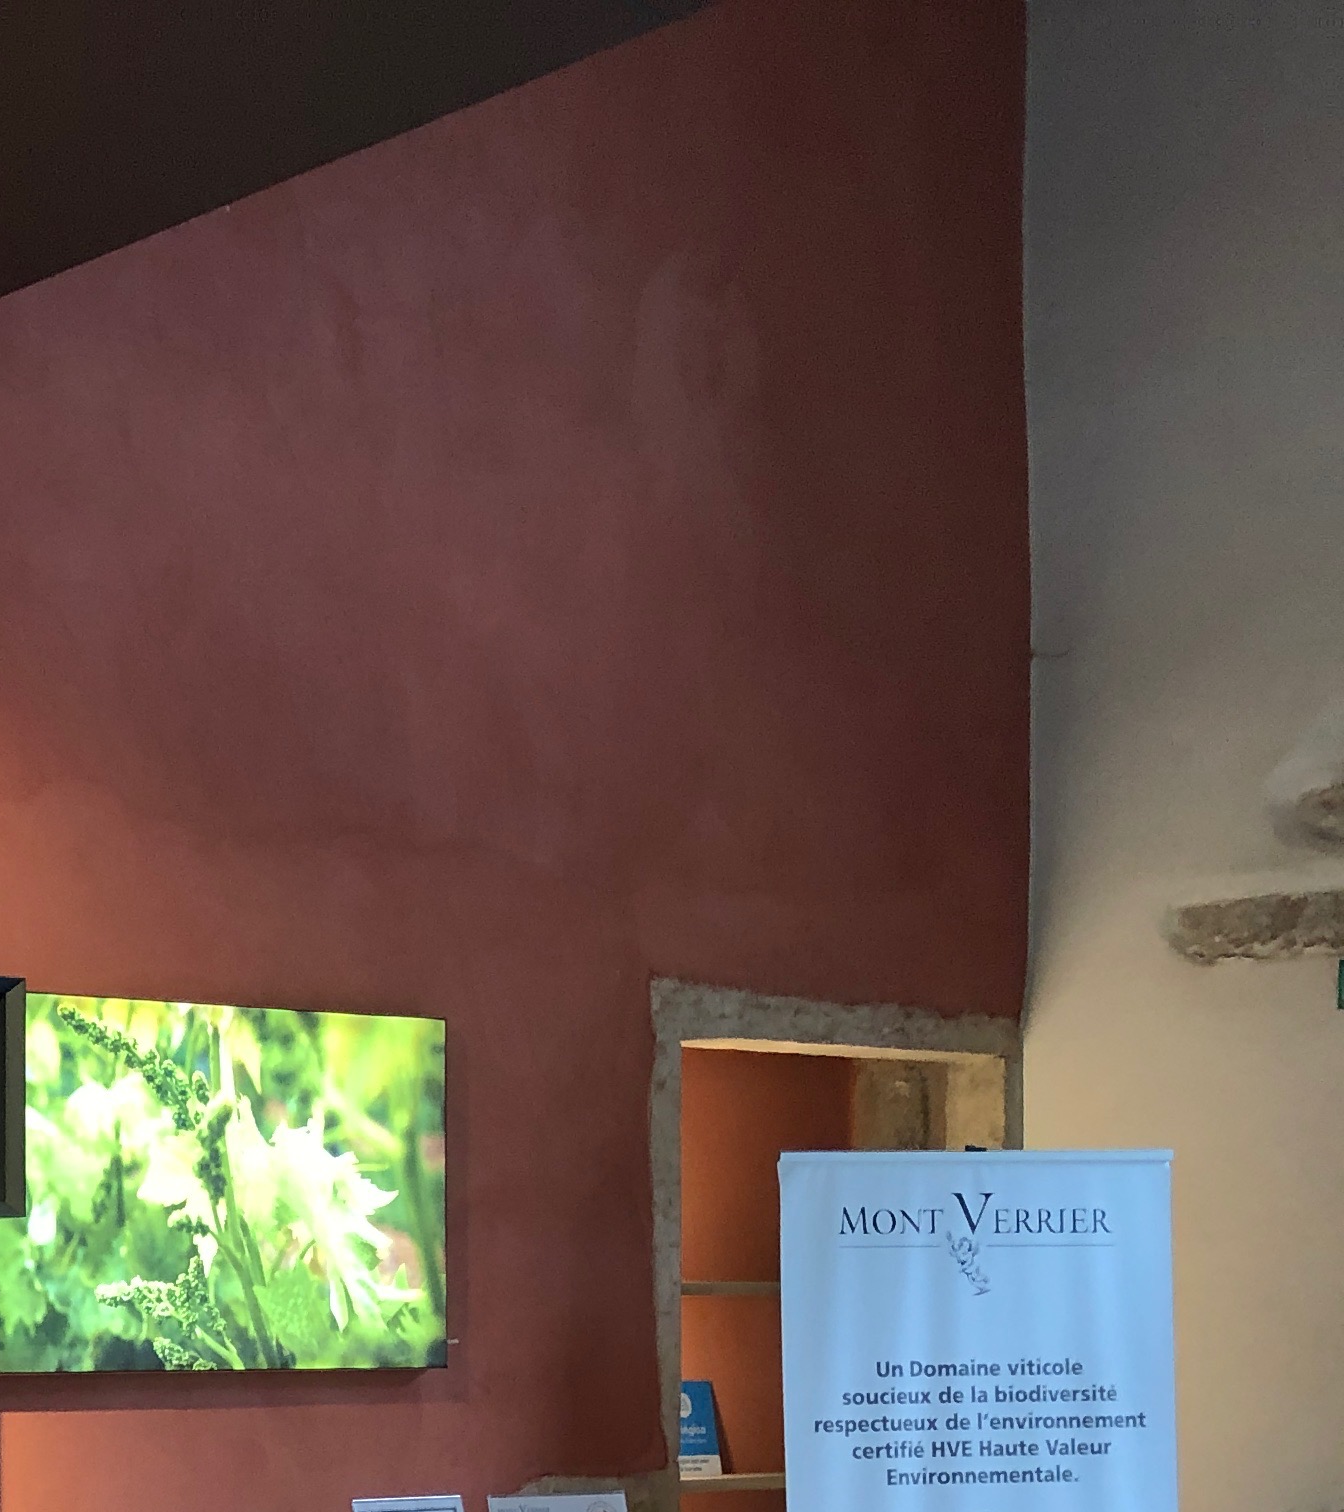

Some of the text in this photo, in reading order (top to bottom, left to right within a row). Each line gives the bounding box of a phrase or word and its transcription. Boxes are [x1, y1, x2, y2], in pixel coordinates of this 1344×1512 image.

[839, 1192, 1112, 1235] MONT VERRIER
[876, 1358, 1084, 1378] Un Domaine viticole
[842, 1384, 1117, 1405] soucieux de la biodiversité
[815, 1410, 1146, 1437] respectueux de l'environnement
[852, 1438, 1112, 1459] certifié HVE Haute Valeur
[887, 1464, 1078, 1486] Environnementale.
